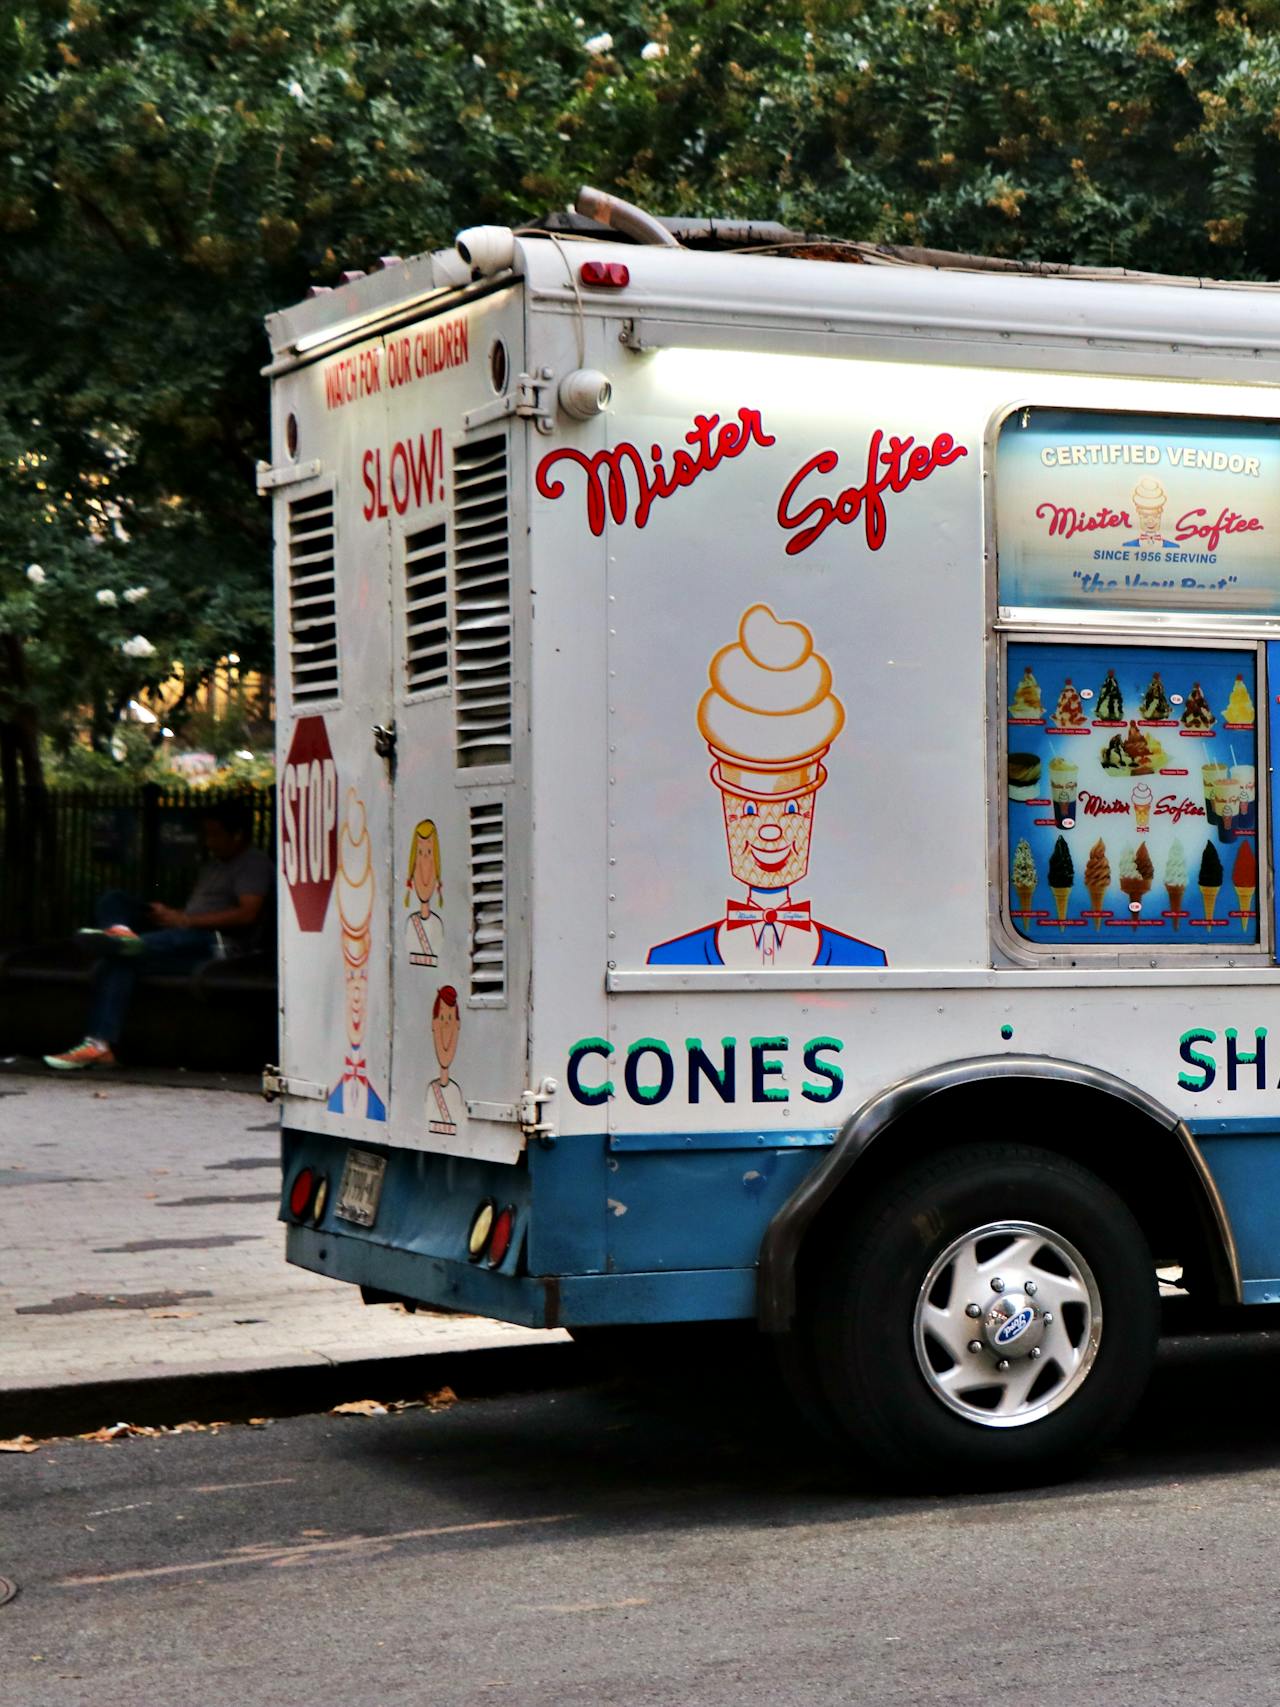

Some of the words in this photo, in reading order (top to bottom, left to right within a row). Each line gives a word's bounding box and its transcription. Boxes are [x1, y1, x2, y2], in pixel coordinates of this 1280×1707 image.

[325, 359, 358, 410] WATCH
[360, 347, 382, 394] FOR
[387, 330, 412, 390] OUR
[415, 316, 469, 380] CHILDREN
[362, 427, 447, 523] SLOW!
[535, 407, 776, 537] Mister
[777, 429, 968, 556] Softee
[1041, 445, 1161, 467] CERTIFIED
[1167, 446, 1260, 477] VENDOR
[1035, 502, 1133, 540] Mister
[1174, 507, 1264, 552] Softee
[1093, 549, 1130, 562] SINCE
[1134, 551, 1161, 563] 1956
[1164, 552, 1217, 565] SERVING
[284, 759, 336, 886] STOP
[1078, 790, 1131, 817] Mister
[1153, 795, 1206, 824] Softee
[567, 1036, 844, 1106] CONES
